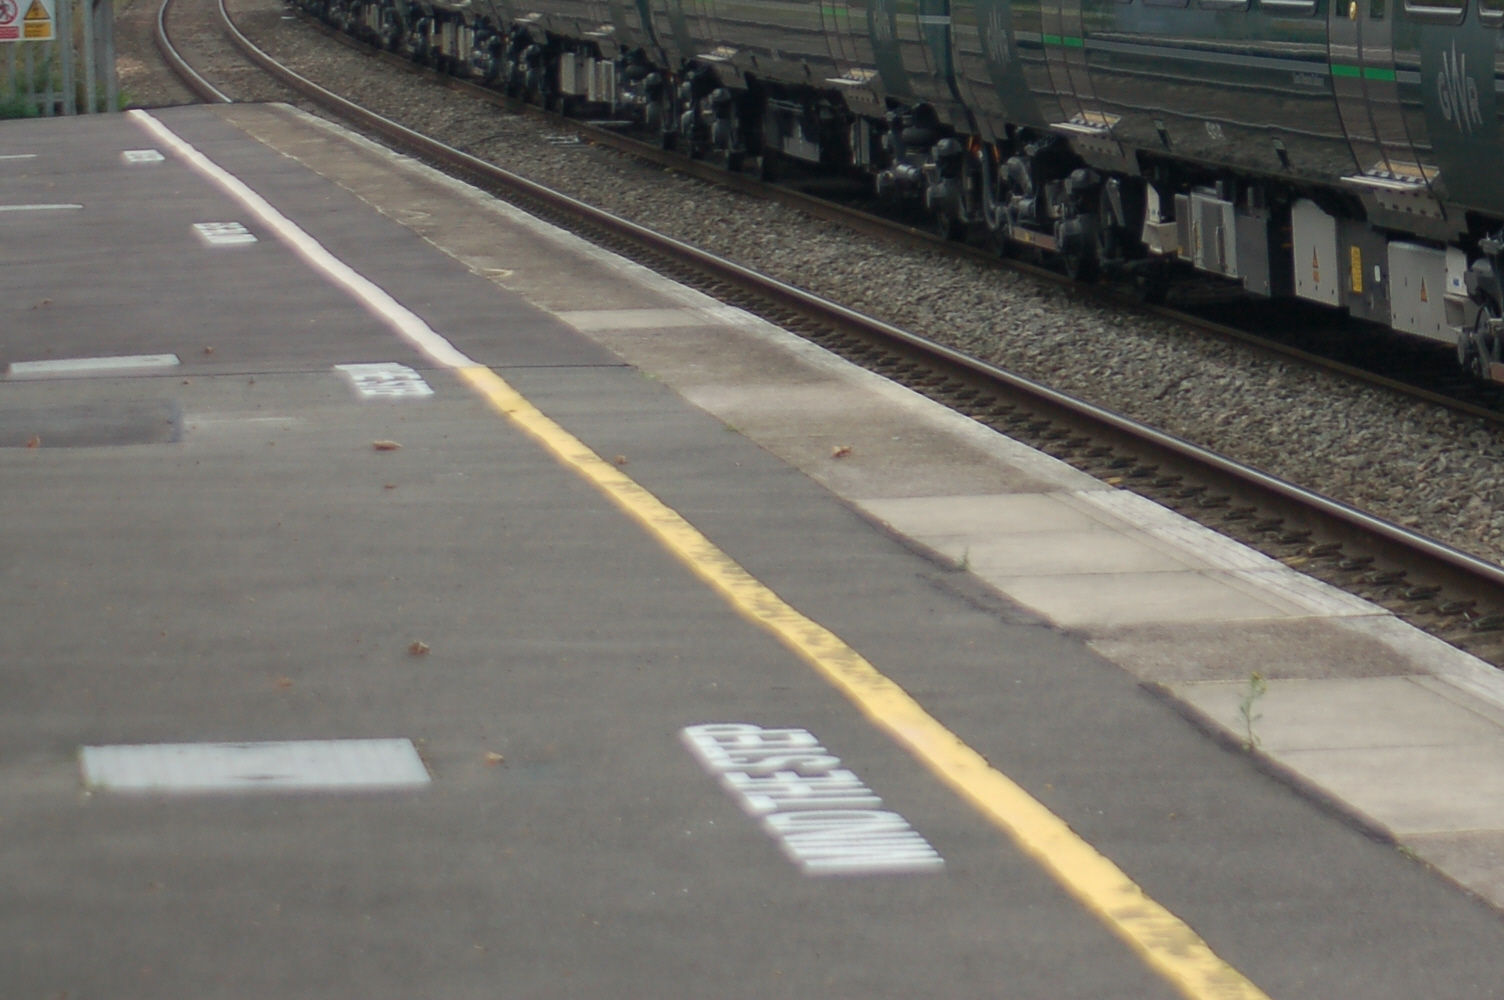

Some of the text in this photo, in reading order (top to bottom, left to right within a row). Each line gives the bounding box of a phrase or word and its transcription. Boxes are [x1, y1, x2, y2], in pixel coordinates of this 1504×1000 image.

[1437, 38, 1483, 136] GWR
[683, 723, 945, 870] MIND THE STEP
